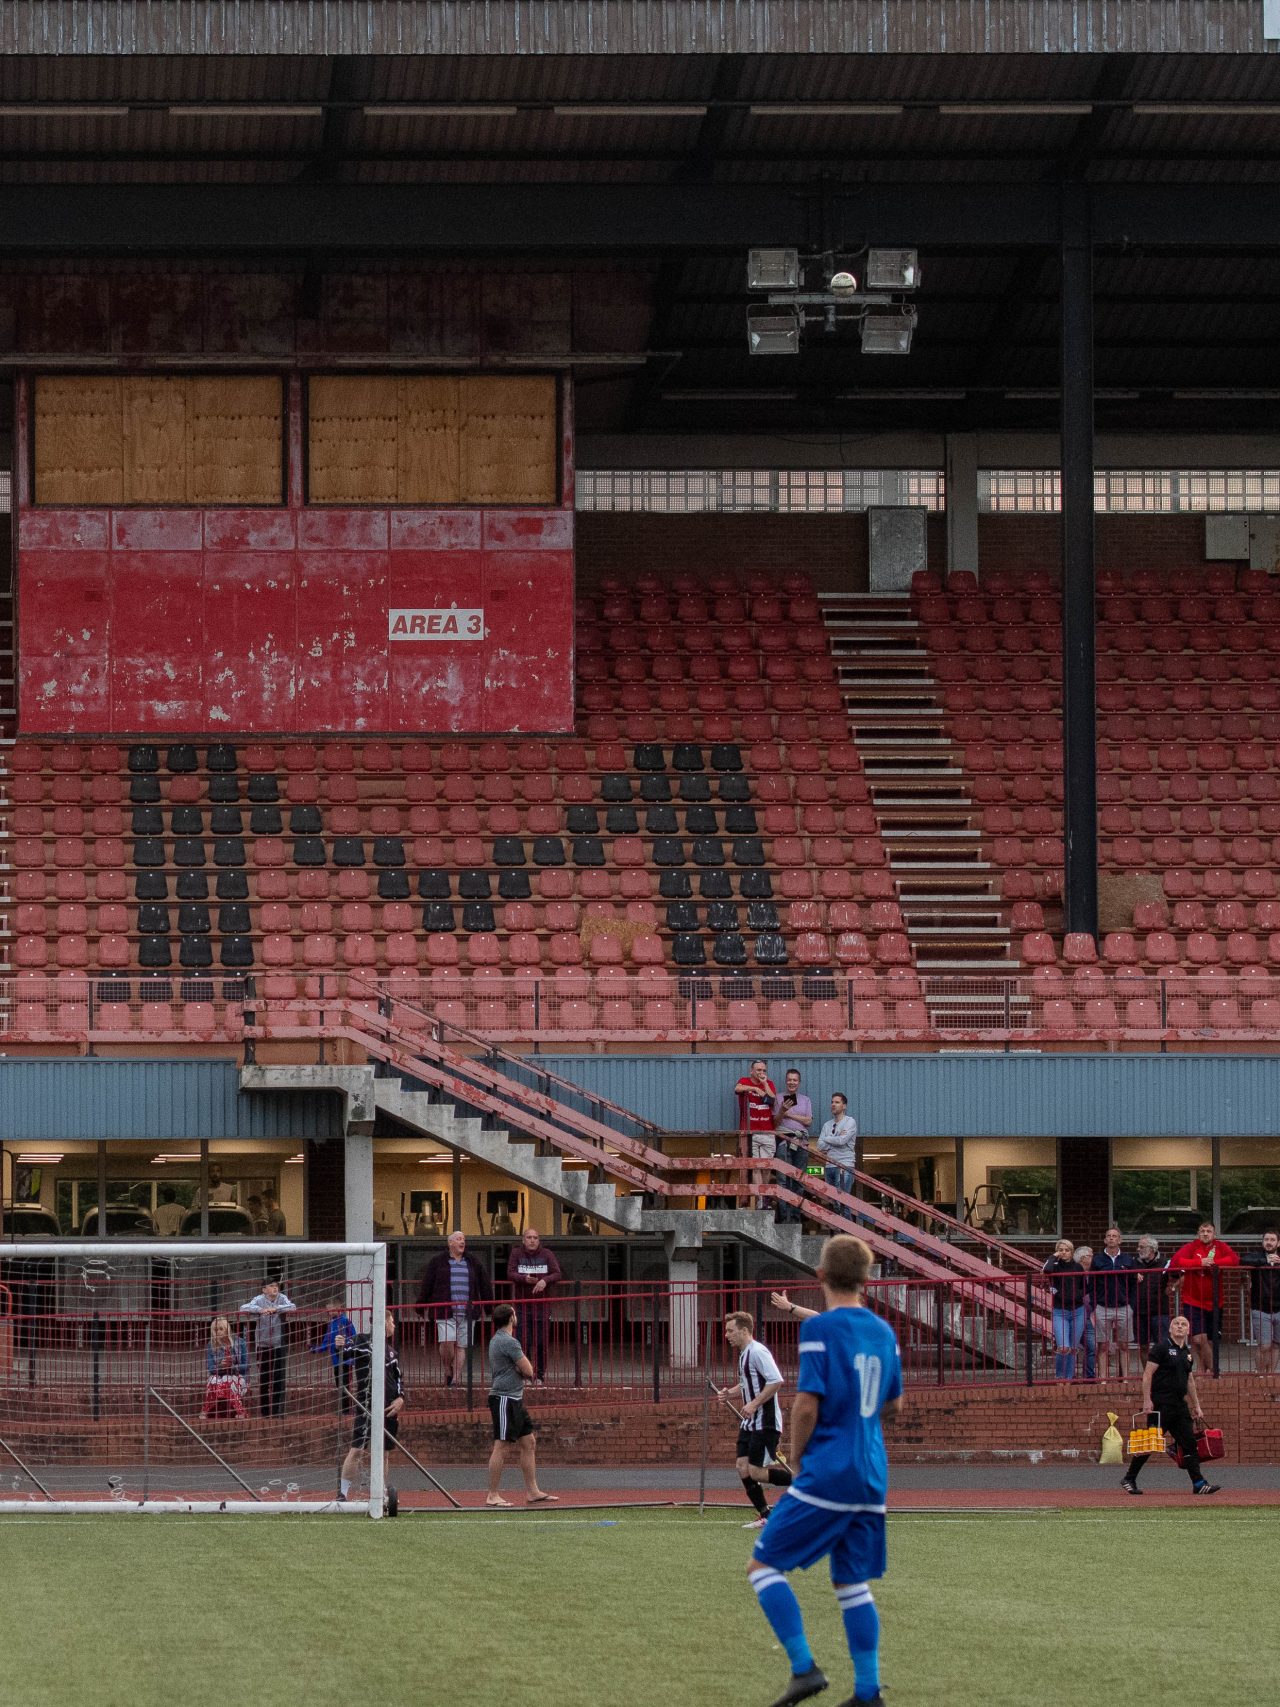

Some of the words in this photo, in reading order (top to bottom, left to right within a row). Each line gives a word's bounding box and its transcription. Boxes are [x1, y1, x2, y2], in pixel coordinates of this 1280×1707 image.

[392, 615, 459, 634] AREA
[467, 615, 482, 635] 3
[853, 1353, 881, 1418] 10
